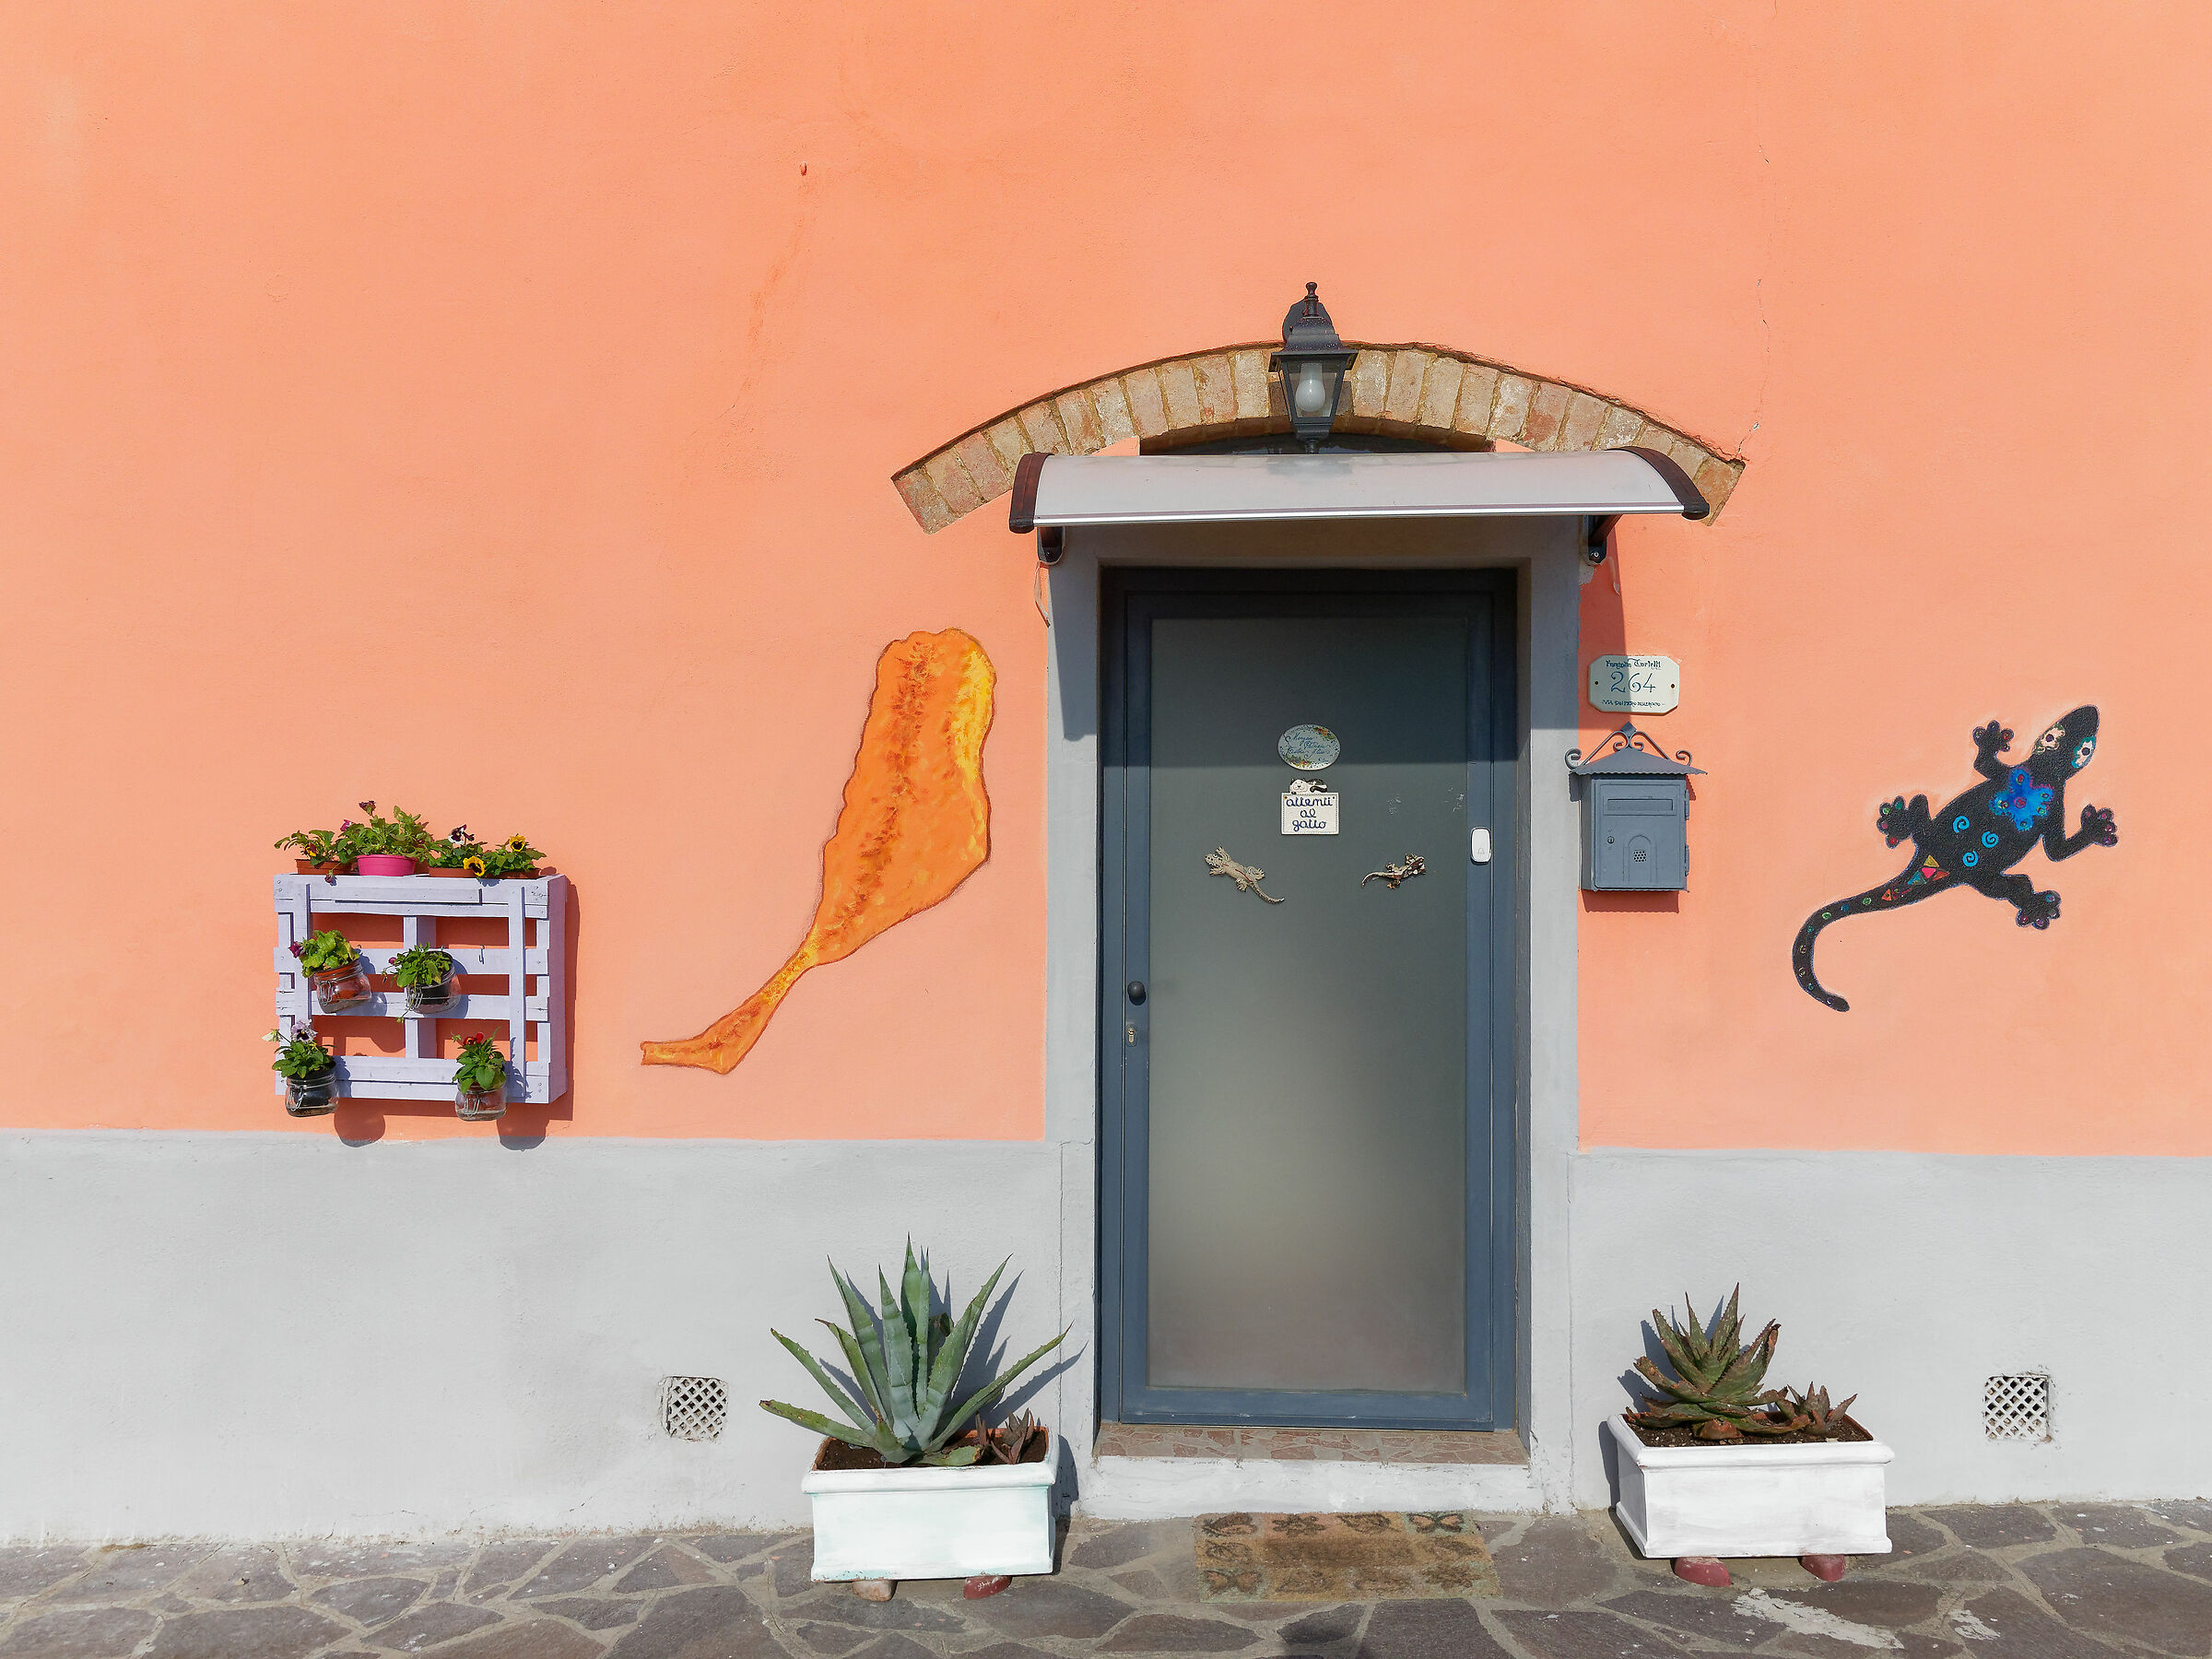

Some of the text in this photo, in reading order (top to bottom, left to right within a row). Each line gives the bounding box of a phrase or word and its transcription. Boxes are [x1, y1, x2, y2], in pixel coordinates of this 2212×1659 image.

[1610, 671, 1656, 693] 264
[1286, 796, 1333, 806] attenti
[1300, 808, 1316, 818] al
[1292, 819, 1326, 831] gatto
